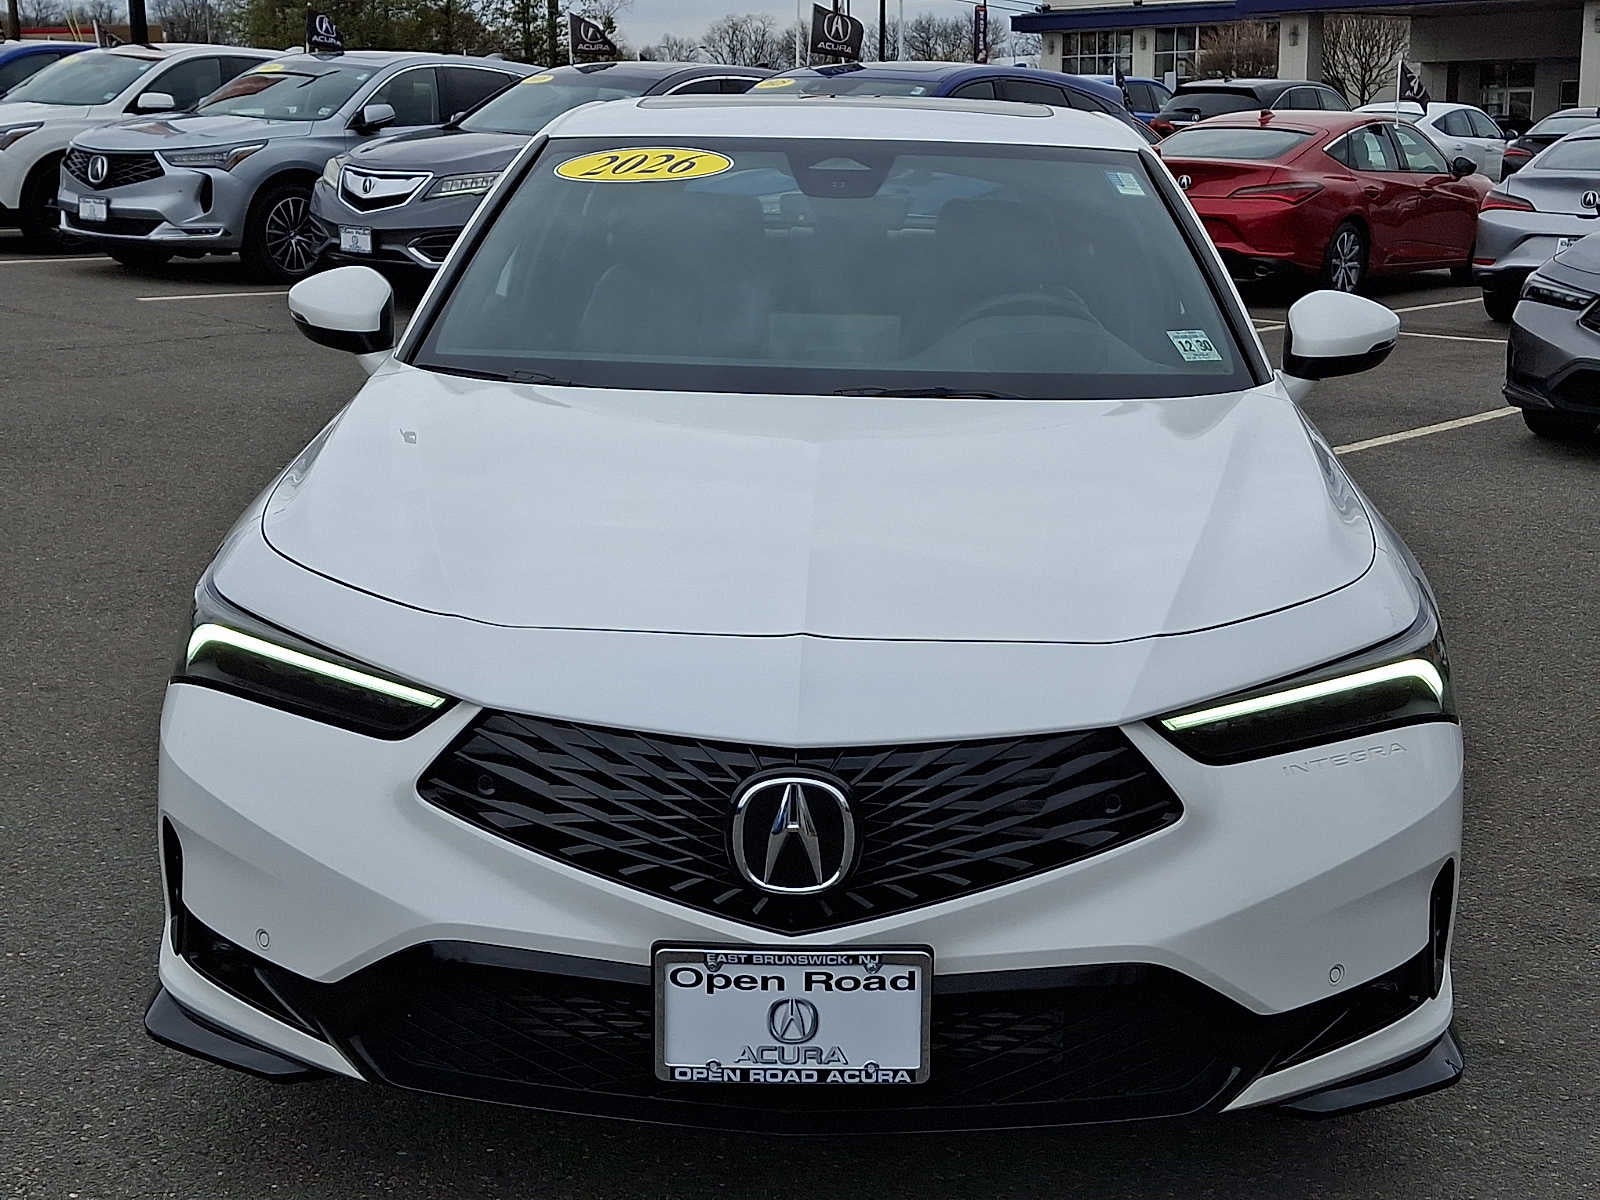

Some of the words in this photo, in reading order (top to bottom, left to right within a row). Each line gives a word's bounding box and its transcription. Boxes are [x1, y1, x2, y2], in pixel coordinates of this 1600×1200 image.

[817, 42, 851, 53] ACURA
[579, 154, 709, 176] 2026
[1178, 340, 1196, 352] 12
[1281, 742, 1408, 776] INTEGRA
[706, 953, 749, 964] EAST
[859, 954, 879, 964] NJ
[669, 966, 786, 995] Open
[803, 970, 916, 993] Road
[734, 1045, 849, 1065] ACURA
[674, 1067, 741, 1082] OPEN
[750, 1069, 818, 1083] ROAD
[826, 1069, 911, 1083] ACURA
